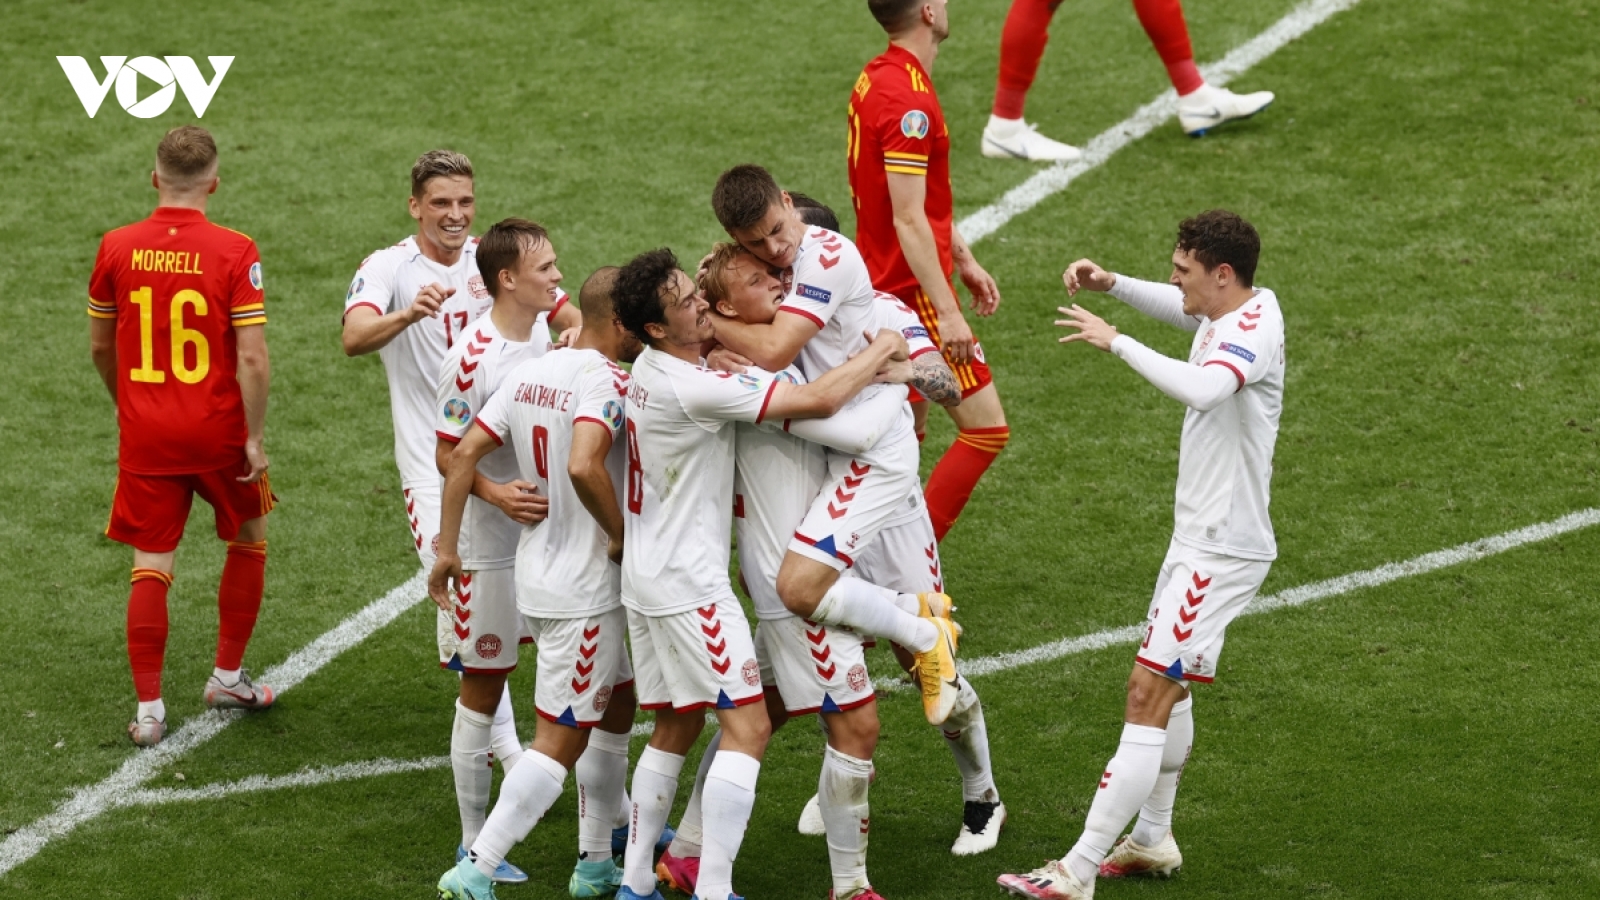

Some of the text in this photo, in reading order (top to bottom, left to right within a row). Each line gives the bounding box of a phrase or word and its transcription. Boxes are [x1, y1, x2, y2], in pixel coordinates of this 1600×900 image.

[131, 248, 203, 275] MORRELL
[803, 288, 830, 302] RESPECT
[129, 286, 210, 385] 16
[443, 310, 468, 349] 17
[1229, 345, 1254, 362] RESPECT
[627, 417, 643, 515] 8
